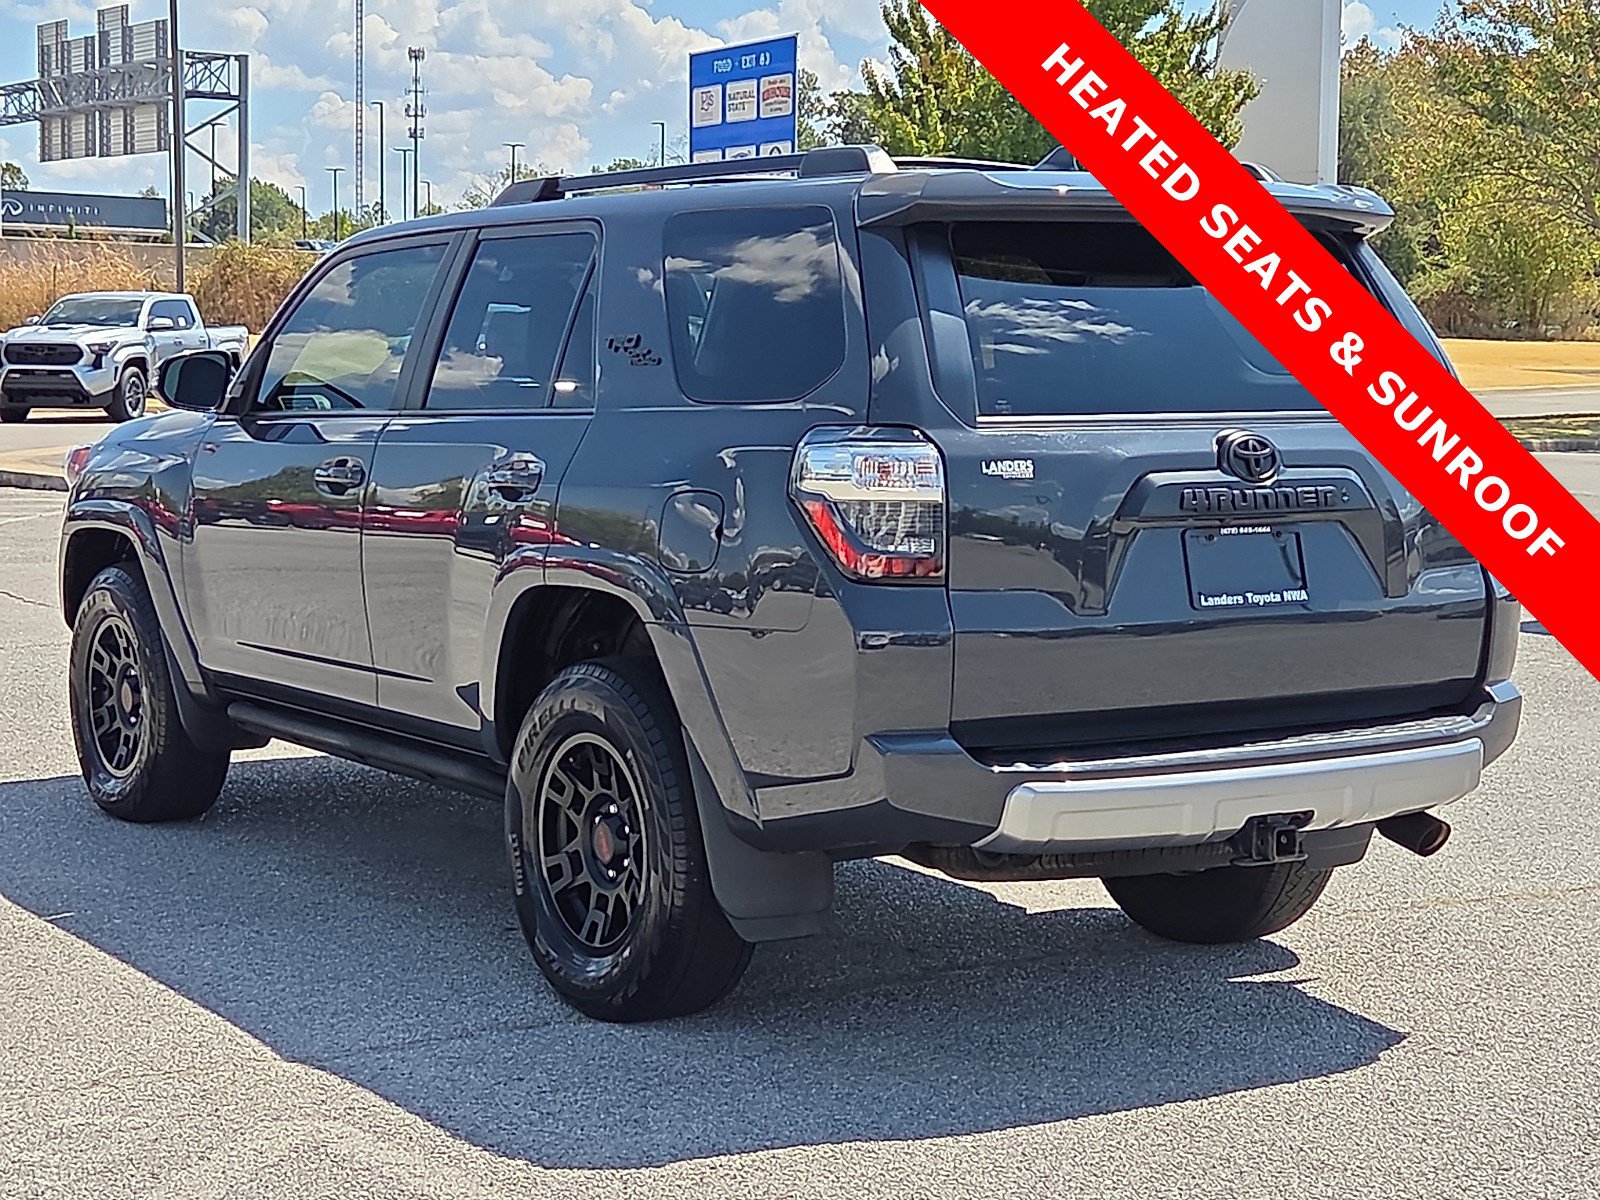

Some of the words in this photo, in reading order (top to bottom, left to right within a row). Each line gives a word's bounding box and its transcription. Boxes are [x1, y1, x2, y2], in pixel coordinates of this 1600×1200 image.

[714, 58, 732, 73] FOOD
[742, 54, 756, 69] EXIT
[28, 203, 99, 216] INFINITI
[981, 460, 1034, 474] LANDERS
[1200, 594, 1244, 607] Landers
[1245, 592, 1282, 606] Toyota
[1283, 589, 1309, 602] NWA
